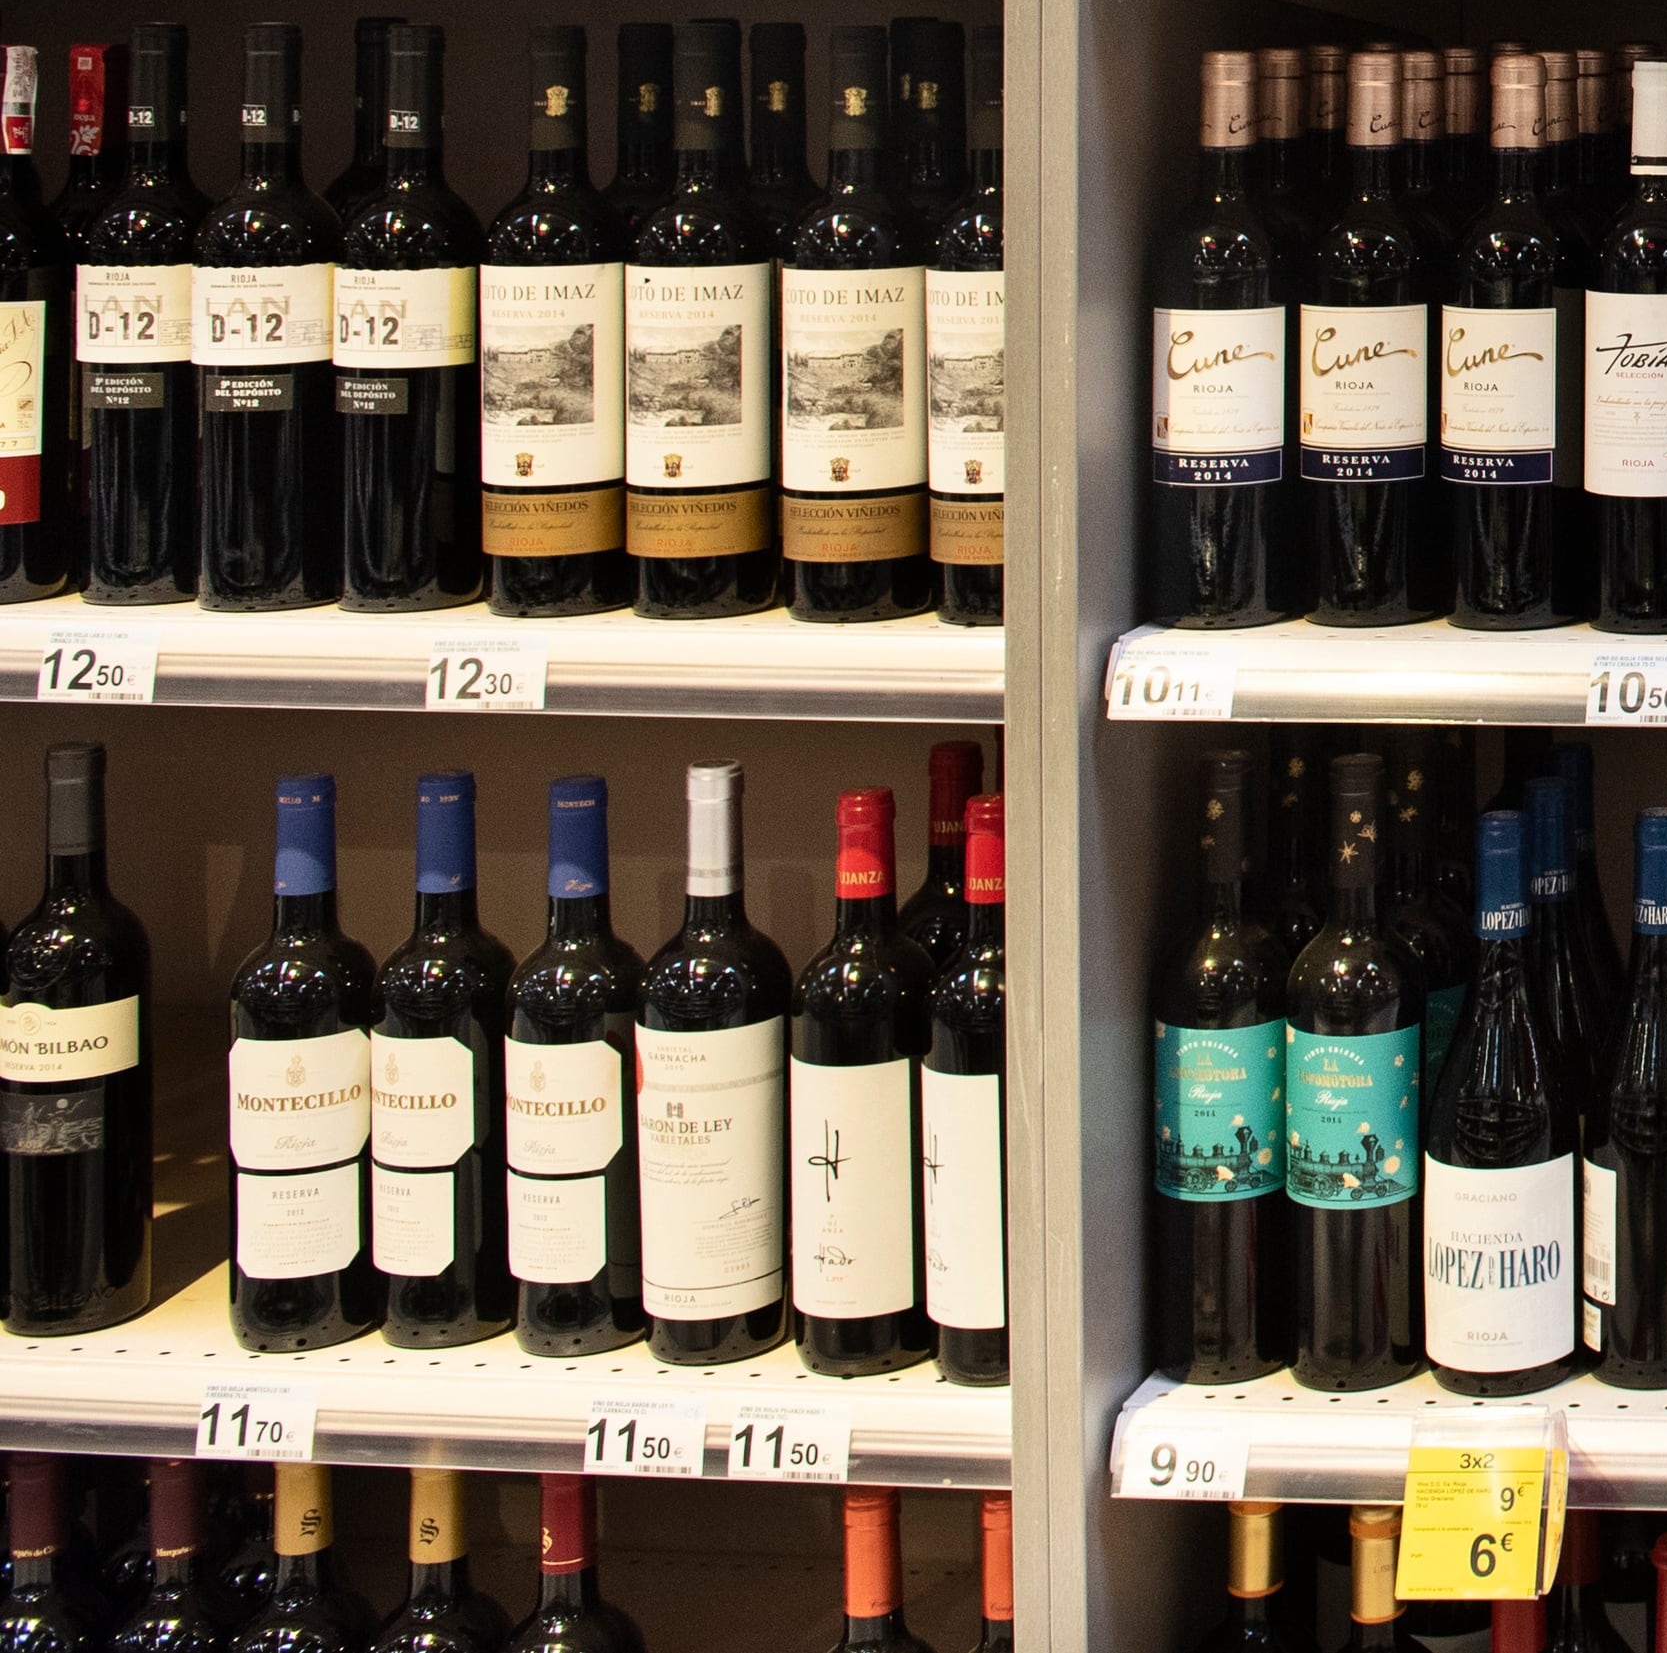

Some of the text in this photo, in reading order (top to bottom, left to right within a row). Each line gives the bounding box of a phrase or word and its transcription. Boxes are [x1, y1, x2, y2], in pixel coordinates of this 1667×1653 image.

[693, 284, 745, 301] IMAZ
[210, 312, 284, 344] D-12
[1311, 327, 1419, 377] Cune
[232, 378, 275, 389] EDICIÓN
[1615, 371, 1665, 380] SELECCIÓN
[214, 386, 282, 398] DEL DEPÓSITO
[1321, 454, 1391, 466] RESERVA
[42, 648, 124, 692] 12 50
[428, 657, 512, 700] 12 30
[1115, 664, 1201, 706] 10 11
[1590, 671, 1646, 713] 10
[647, 1052, 708, 1064] GARNACHA
[236, 1083, 362, 1113] MONTECILLO
[650, 1133, 712, 1145] VARIETALES
[703, 1117, 733, 1133] LEY
[1450, 1230, 1524, 1246] HACIENDA
[1428, 1238, 1561, 1291] LOPEZ HARO
[201, 1403, 283, 1447] 11 70
[588, 1418, 671, 1462] 11 50
[735, 1424, 819, 1469] 11 50
[1459, 1453, 1495, 1469] 3x2
[1150, 1442, 1216, 1487] 9 90
[1500, 1487, 1515, 1512] 9
[1470, 1533, 1497, 1578] 6
